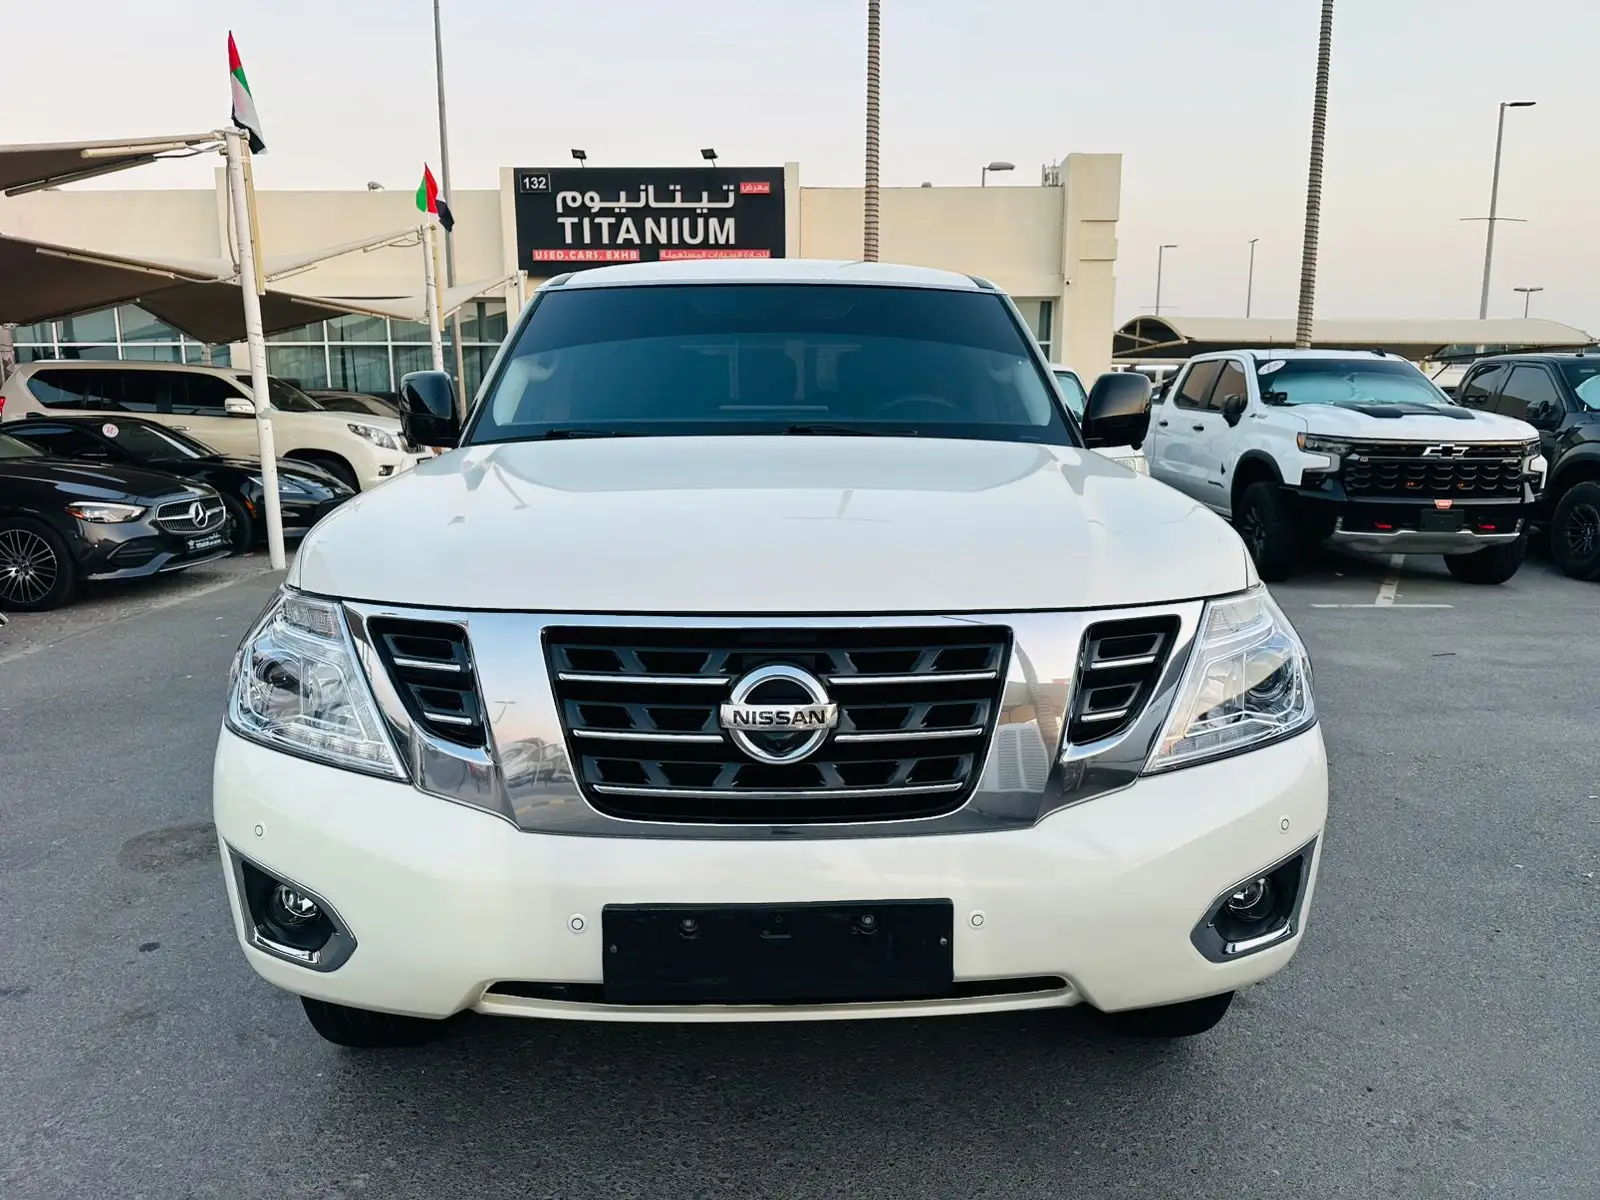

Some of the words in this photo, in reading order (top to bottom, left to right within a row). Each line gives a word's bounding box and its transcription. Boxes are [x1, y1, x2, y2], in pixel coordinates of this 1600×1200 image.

[523, 177, 547, 189] 132
[556, 184, 735, 213] تيتانيوم
[557, 217, 735, 244] TITANIUM
[605, 250, 637, 260] EXHB
[733, 710, 825, 725] NISSAN
